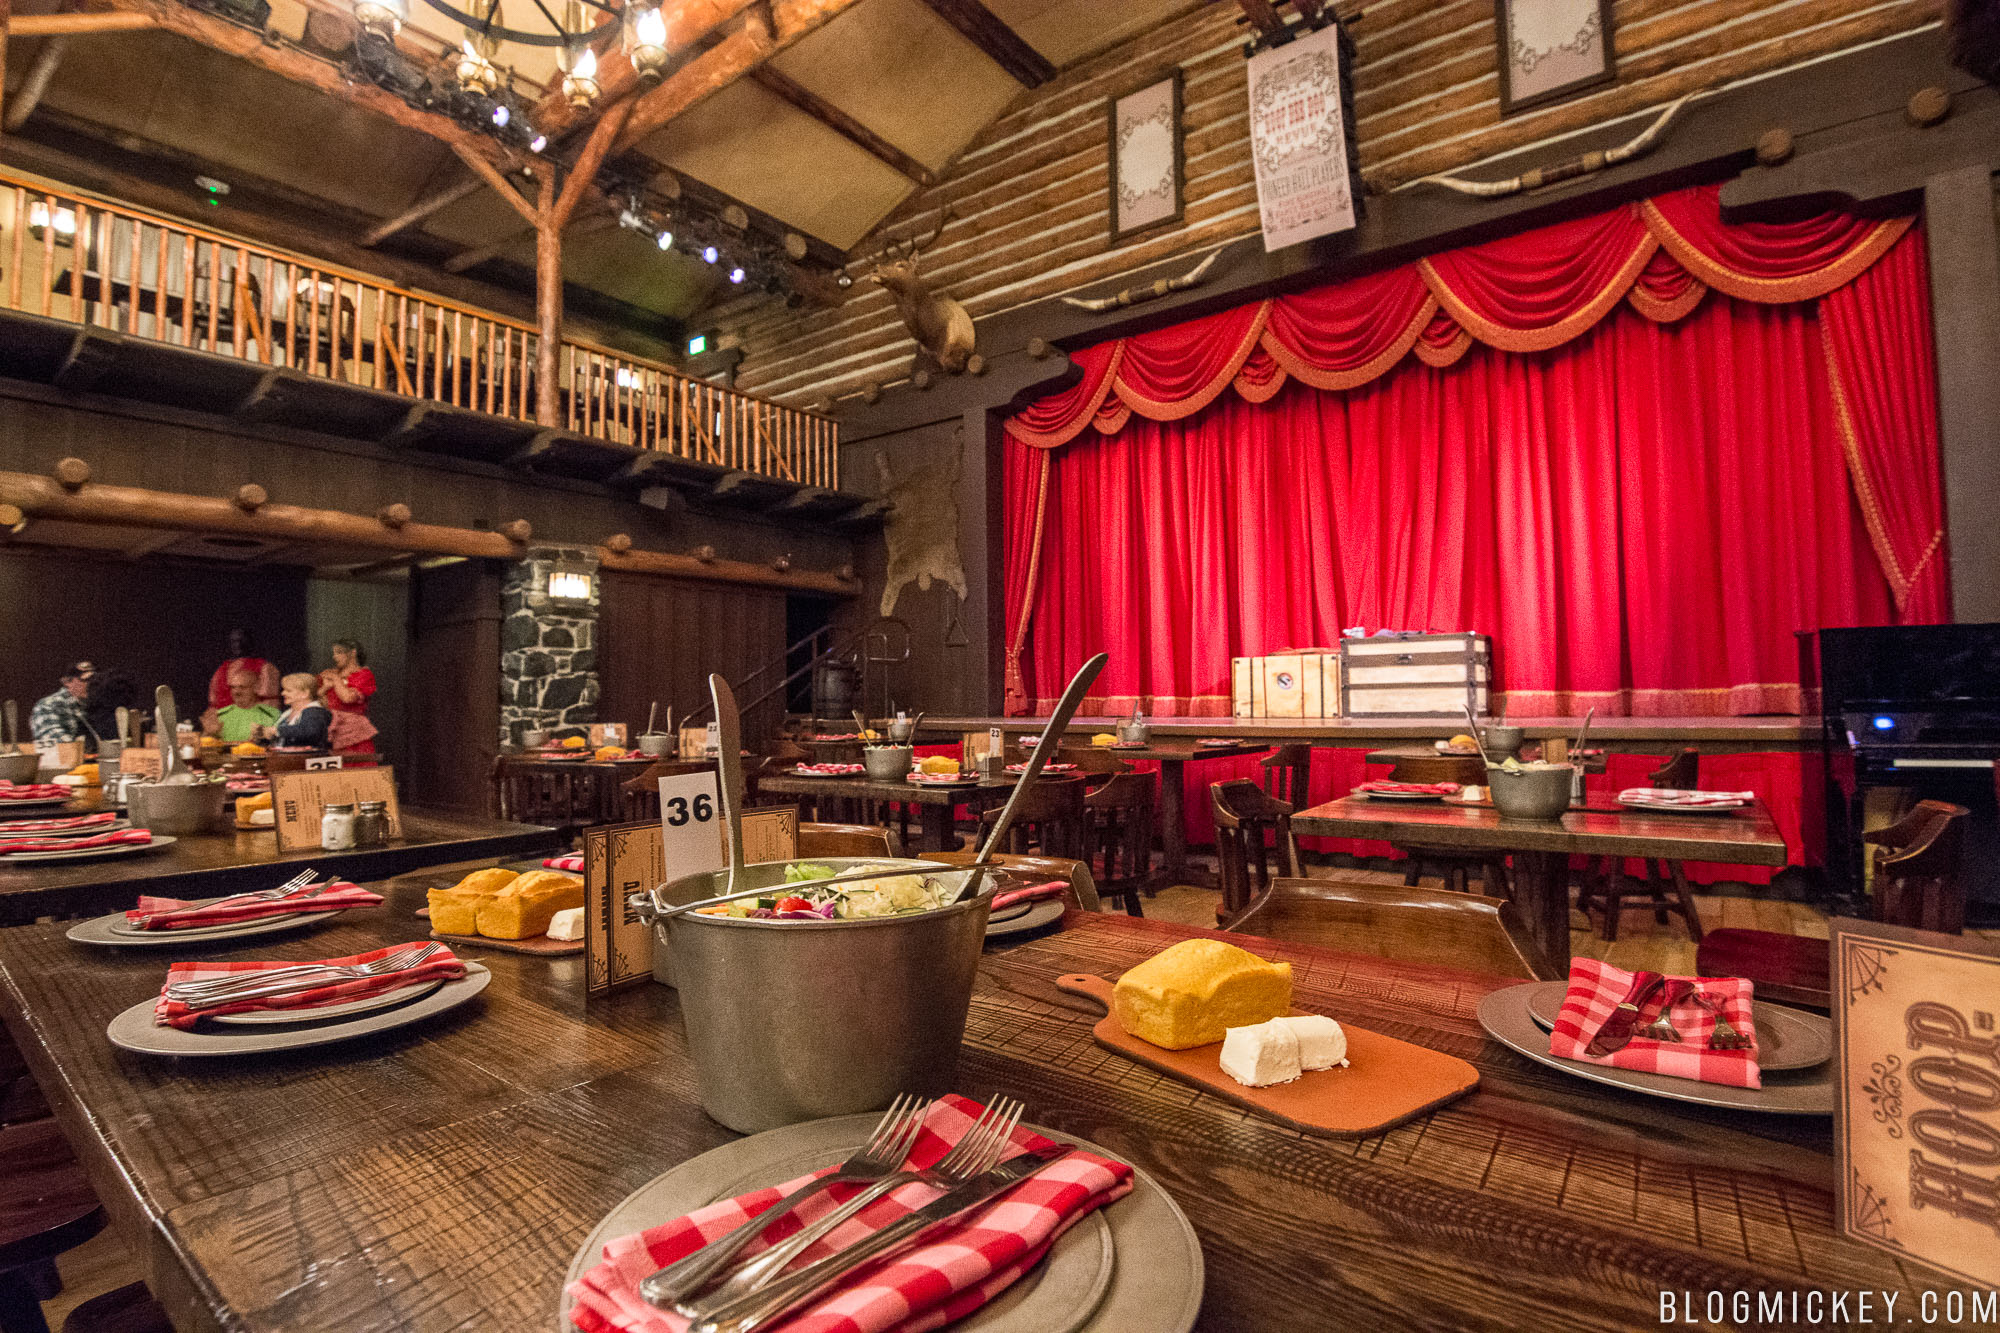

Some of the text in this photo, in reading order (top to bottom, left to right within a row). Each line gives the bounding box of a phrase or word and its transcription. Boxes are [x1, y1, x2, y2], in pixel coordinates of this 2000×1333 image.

[991, 729, 1000, 737] 23
[285, 800, 296, 822] MENU
[667, 794, 713, 826] 36
